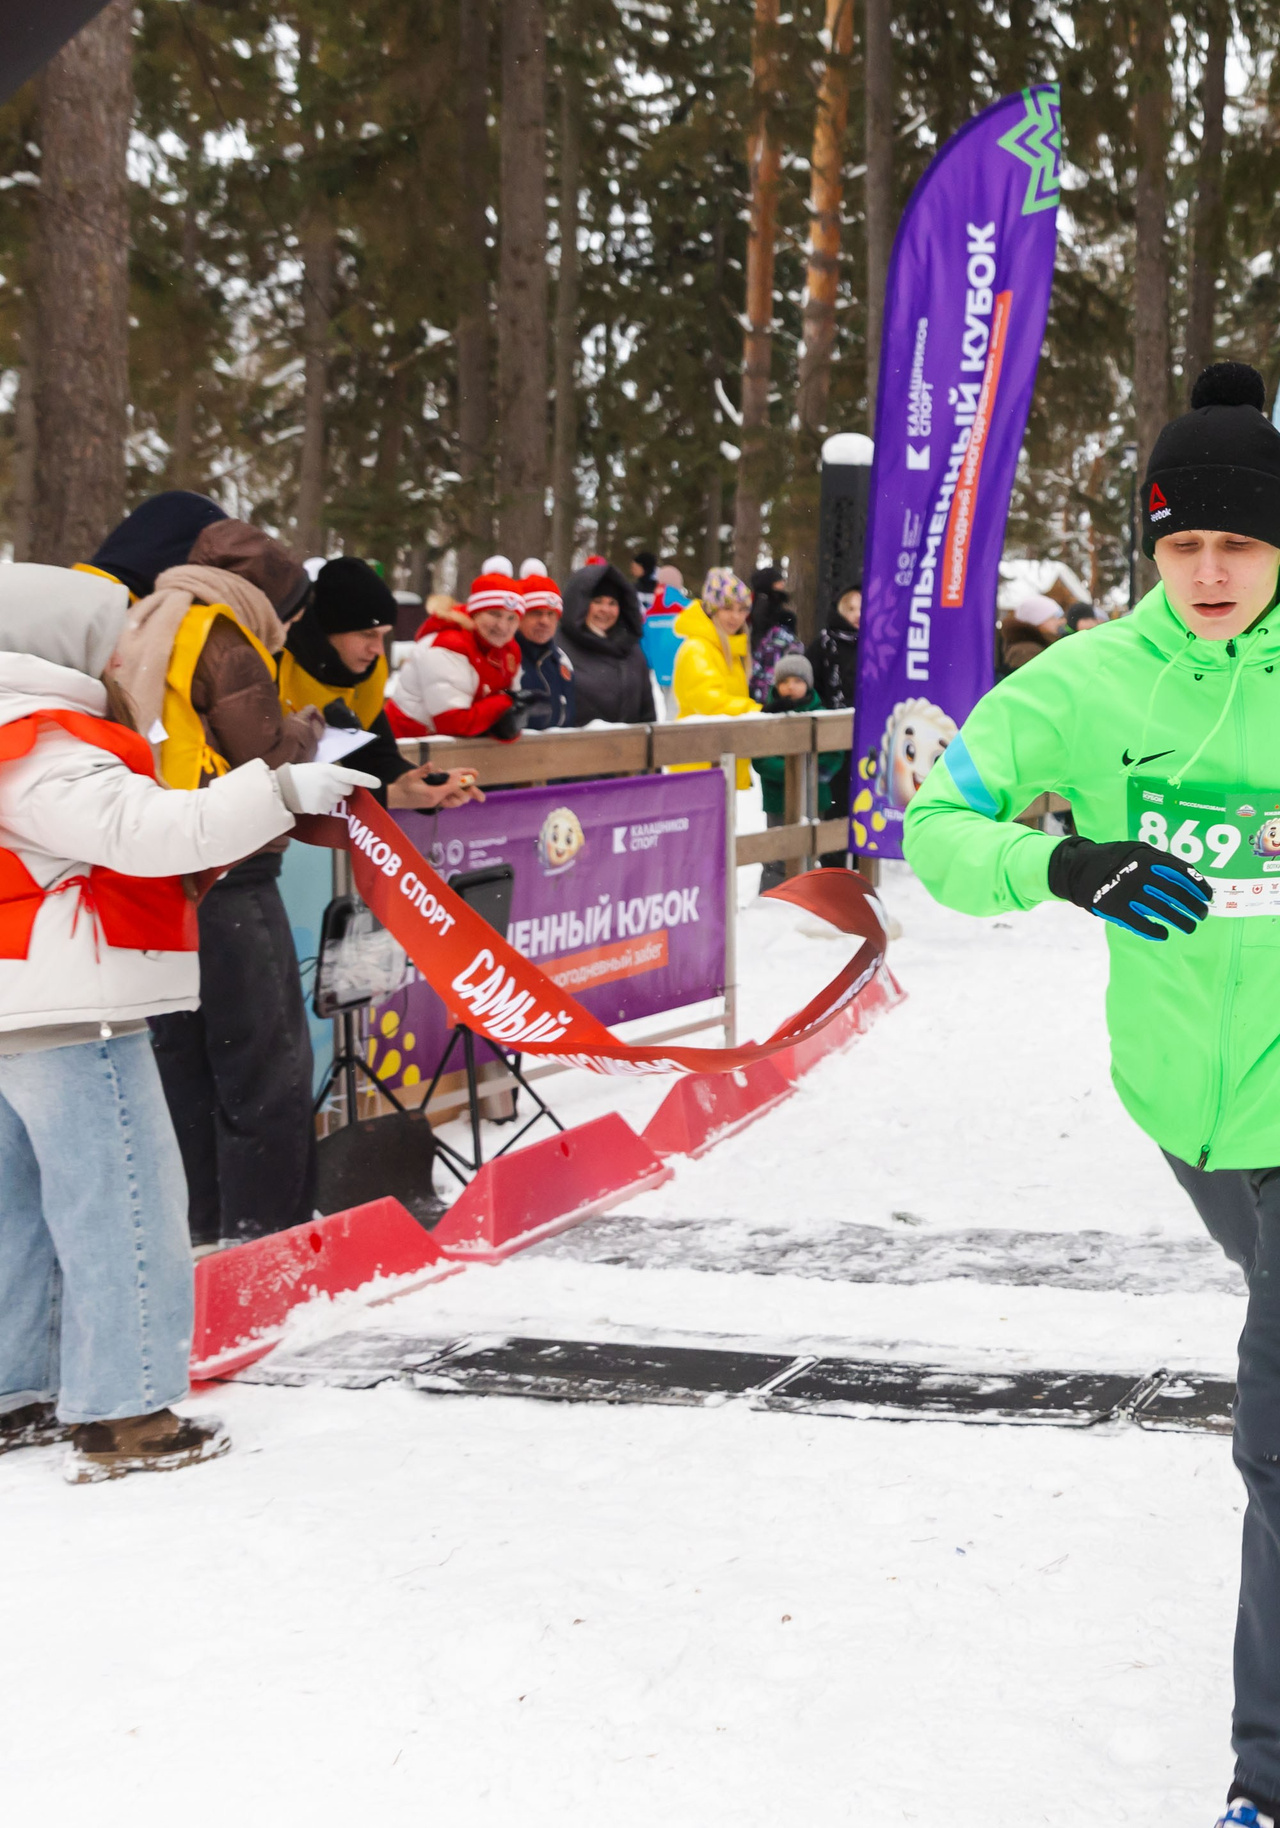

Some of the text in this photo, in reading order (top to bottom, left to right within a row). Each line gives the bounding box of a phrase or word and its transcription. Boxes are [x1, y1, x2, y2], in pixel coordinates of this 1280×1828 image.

[907, 317, 929, 437] КАЛАШНИКОВ
[920, 381, 934, 437] СПОРТ
[906, 380, 981, 681] ПЕЛЬМЕННЫЙ
[961, 221, 996, 372] КУБОК
[630, 817, 690, 837] КАЛАШНИКОВ
[630, 834, 660, 850] СПОРТ
[1138, 810, 1242, 869] 869
[400, 872, 456, 936] СПОРТ
[617, 886, 700, 938] КУБОК
[451, 948, 574, 1043] САМЫЙ
